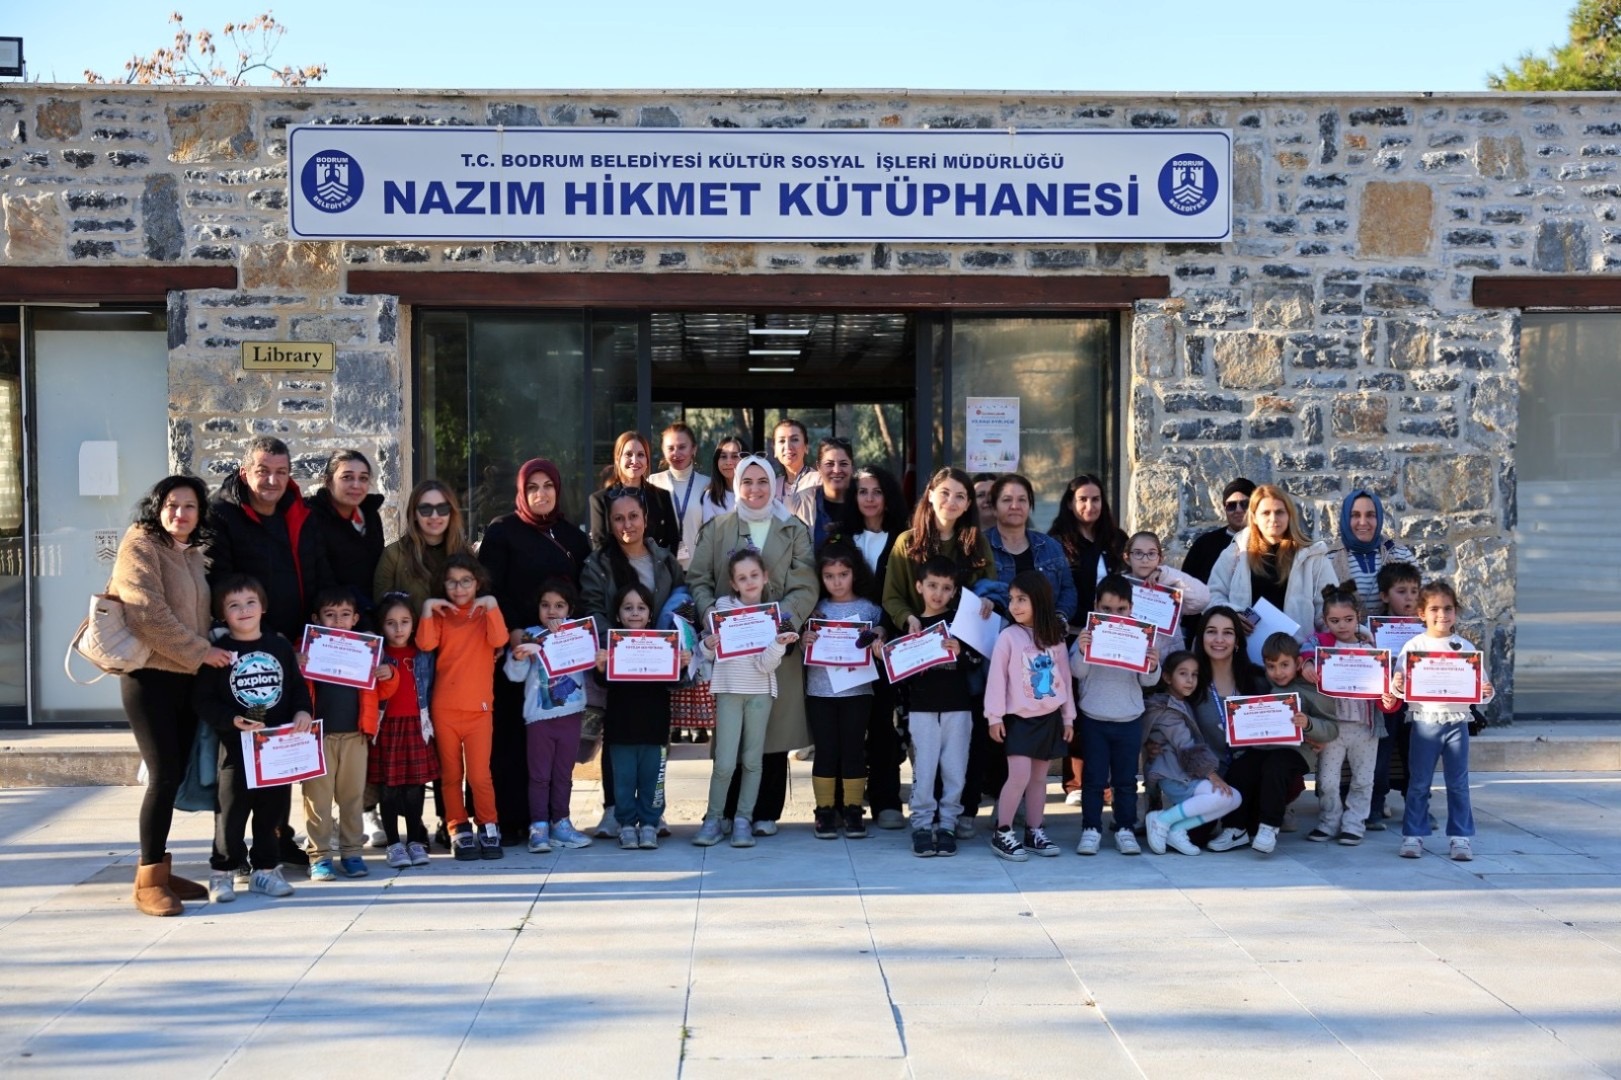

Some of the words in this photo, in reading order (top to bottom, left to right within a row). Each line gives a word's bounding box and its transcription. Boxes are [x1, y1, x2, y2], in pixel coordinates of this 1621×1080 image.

[460, 153, 495, 168] T.C.
[501, 154, 584, 168] BODRUM
[590, 152, 702, 169] BELEDİYESİ
[708, 153, 786, 169] KÜLTÜR
[791, 155, 864, 169] SOSYAL
[876, 152, 937, 172] İŞLERİ
[943, 152, 1064, 169] MÜDÜRLÜĞÜ
[383, 181, 545, 216] NAZIM
[564, 173, 762, 216] HİKMET
[779, 174, 1139, 216] KÜTÜPHANESİ
[253, 346, 323, 368] Library
